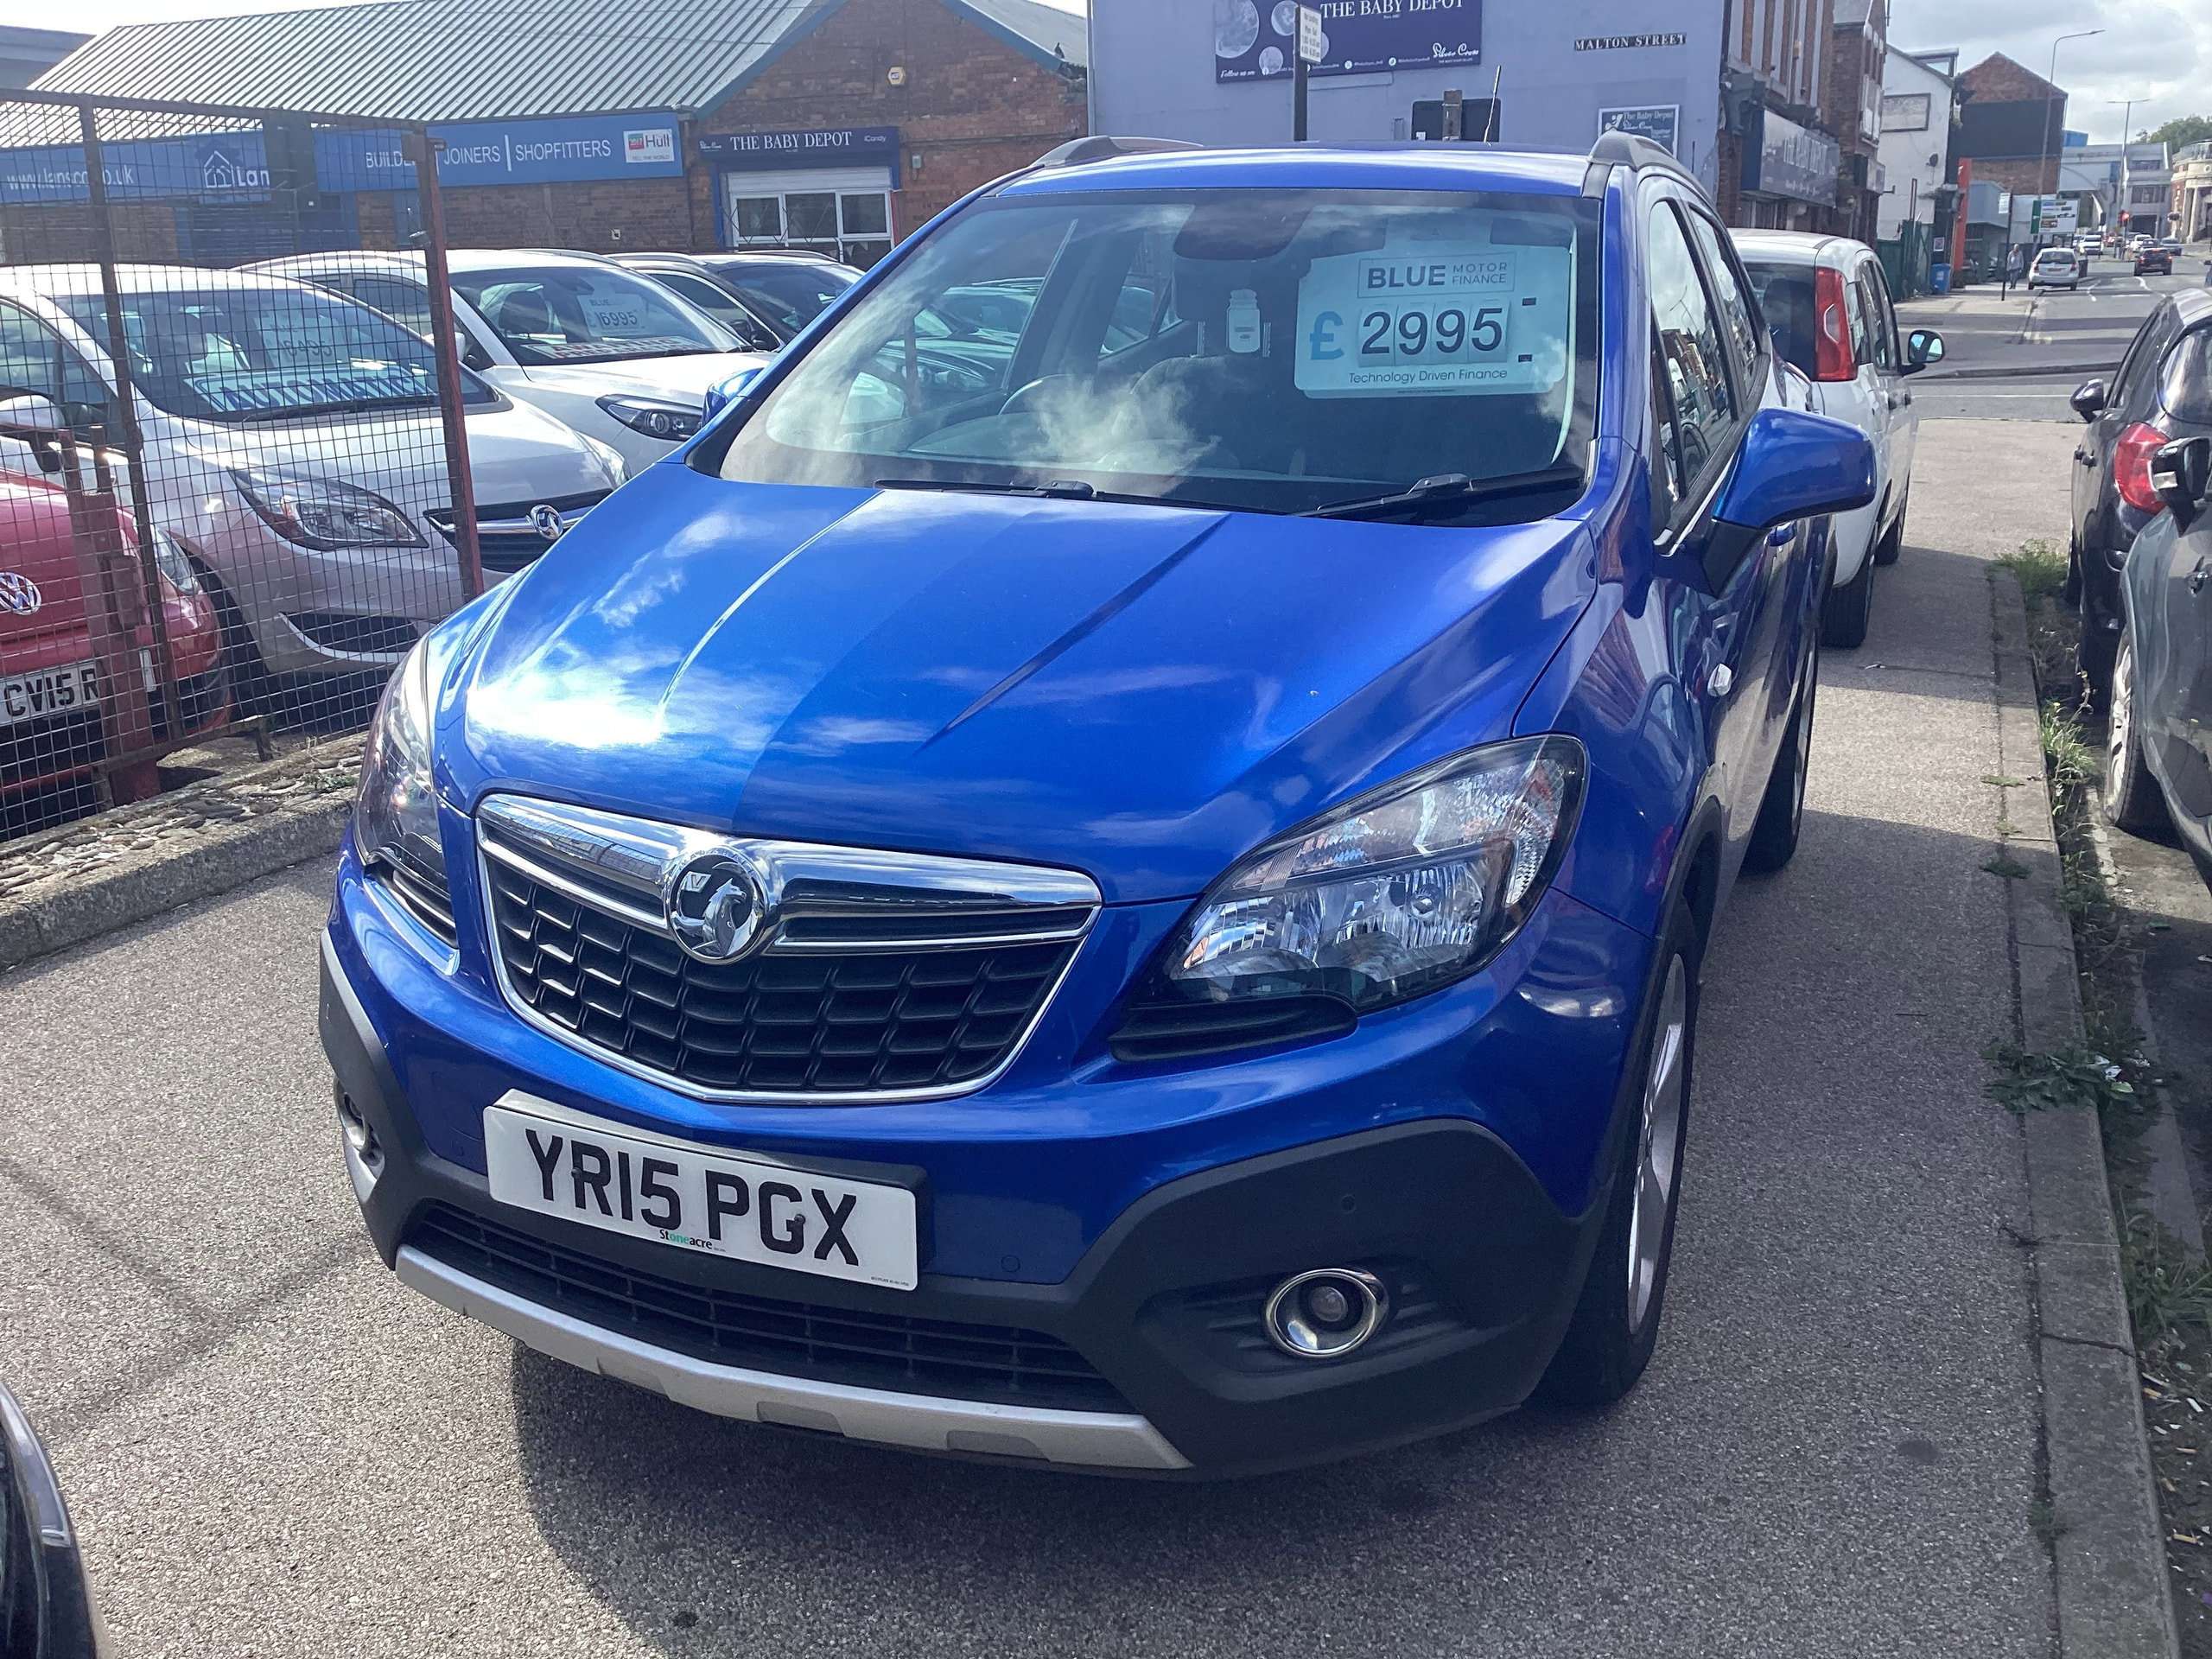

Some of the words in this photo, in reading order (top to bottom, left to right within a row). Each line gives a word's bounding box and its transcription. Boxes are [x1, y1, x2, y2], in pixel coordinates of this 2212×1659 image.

[1320, 2, 1355, 18] THE
[1360, 0, 1402, 16] BABY
[1576, 36, 1629, 50] MALTON
[1636, 34, 1684, 47] STREET
[645, 133, 671, 148] Hull
[730, 136, 760, 151] THE
[764, 134, 799, 149] BABY
[805, 131, 852, 147] DEPOT
[365, 150, 416, 168] BUILD
[443, 146, 500, 165] JOINERS
[515, 140, 611, 162] SHOPFITTERS
[236, 165, 270, 187] Lan
[1368, 264, 1446, 289] BLUE
[1452, 262, 1508, 273] MOTOR
[1452, 273, 1507, 285] FINANCE
[1310, 310, 1344, 359] £
[1361, 308, 1503, 355] 2995
[1349, 372, 1416, 384] Technology
[1419, 370, 1456, 381] Driven
[1459, 368, 1508, 379] Finance
[4, 673, 75, 716] CV15
[524, 1128, 683, 1230] YR15
[704, 1169, 860, 1267] PGX
[659, 1229, 712, 1249] Stoneacre
